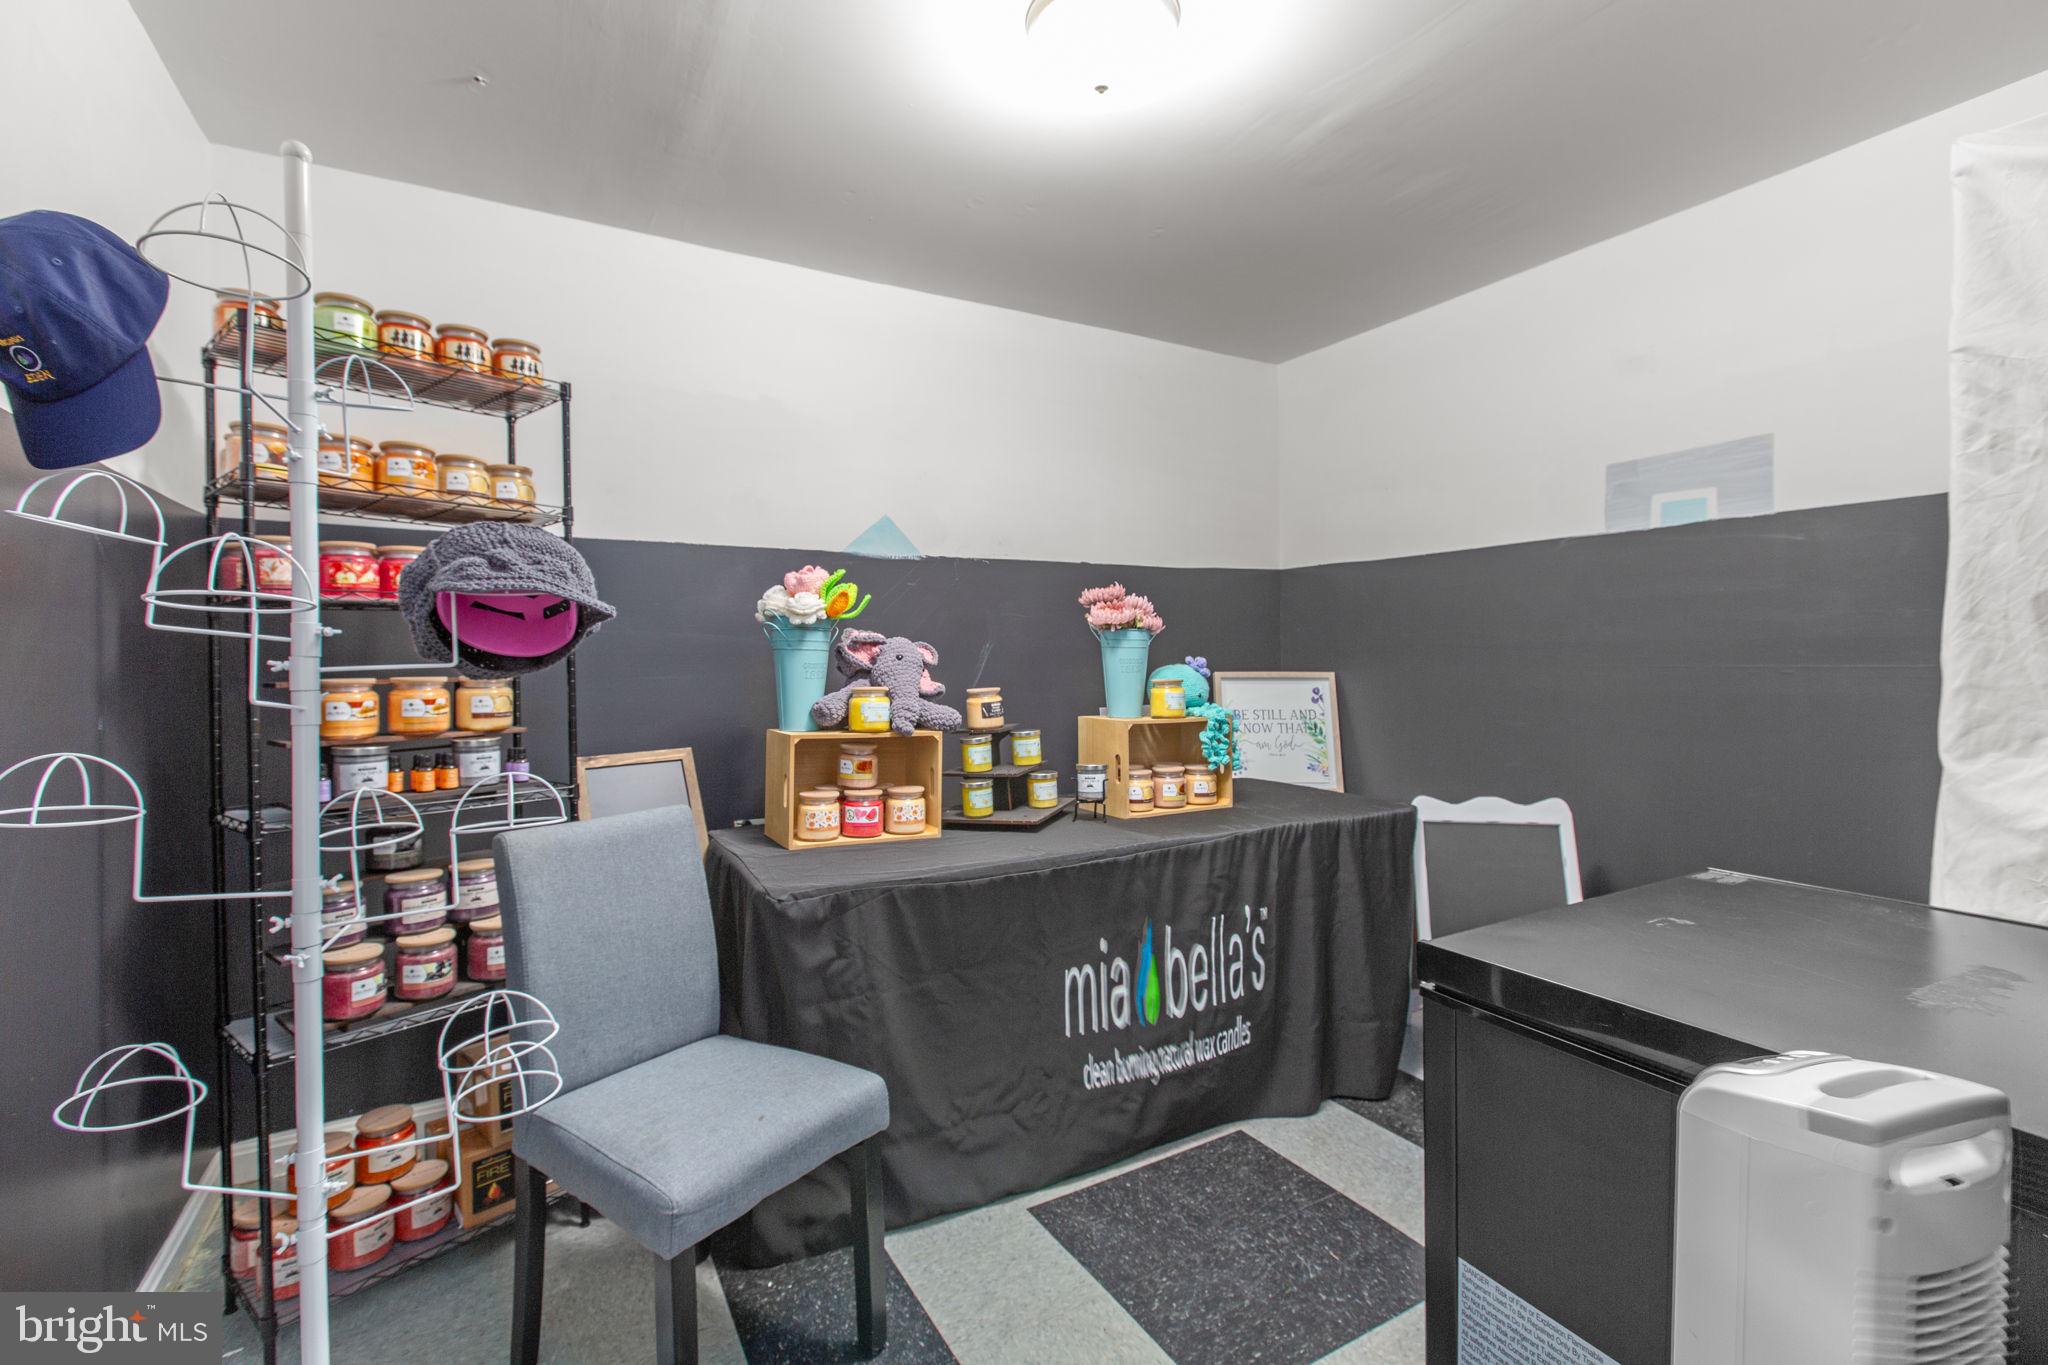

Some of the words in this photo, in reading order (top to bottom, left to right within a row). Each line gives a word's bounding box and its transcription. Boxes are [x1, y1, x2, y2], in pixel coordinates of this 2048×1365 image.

[1233, 709, 1249, 720] BE
[1253, 709, 1286, 720] STILL
[1291, 709, 1316, 720] AND
[1238, 722, 1273, 734] NOW
[1274, 735, 1303, 752] God
[1065, 938, 1131, 1038] mia
[1083, 1053, 1115, 1090] clean
[1157, 1030, 1196, 1075] natural
[1195, 1034, 1217, 1063] wax
[1216, 1014, 1250, 1056] candles
[477, 1161, 511, 1183] FIRE
